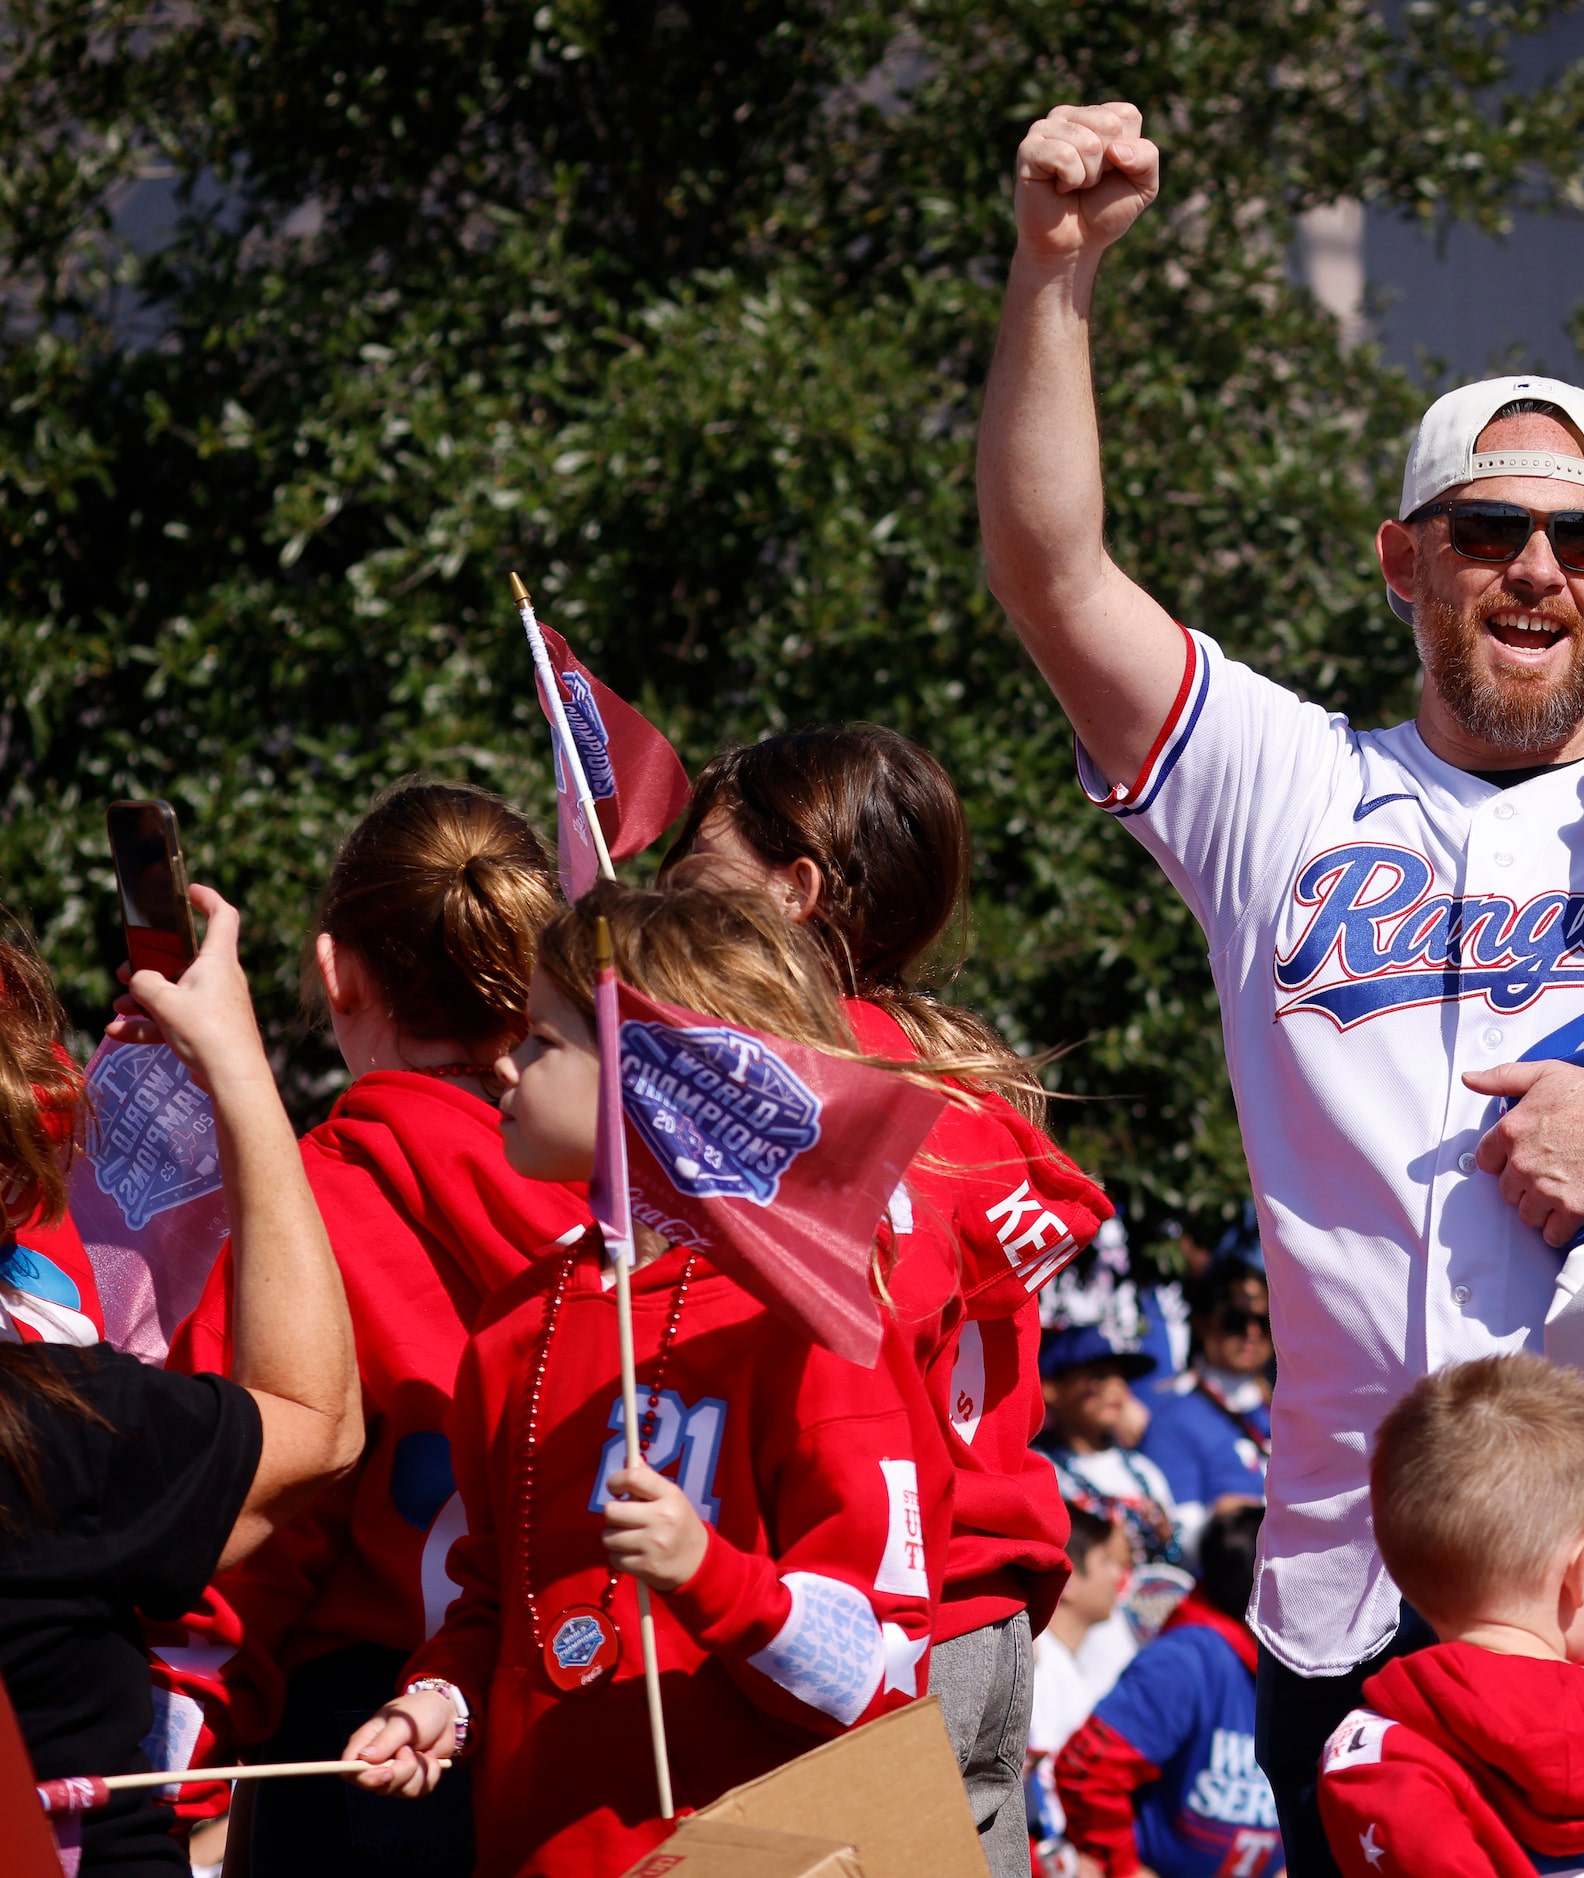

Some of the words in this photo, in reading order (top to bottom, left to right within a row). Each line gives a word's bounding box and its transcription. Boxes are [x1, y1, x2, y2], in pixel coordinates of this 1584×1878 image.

[622, 1054, 787, 1175] CHAMPIONS
[652, 1109, 677, 1134] 20
[703, 1144, 724, 1170] 23
[671, 1050, 780, 1130] WORLD
[588, 1384, 728, 1530] 21
